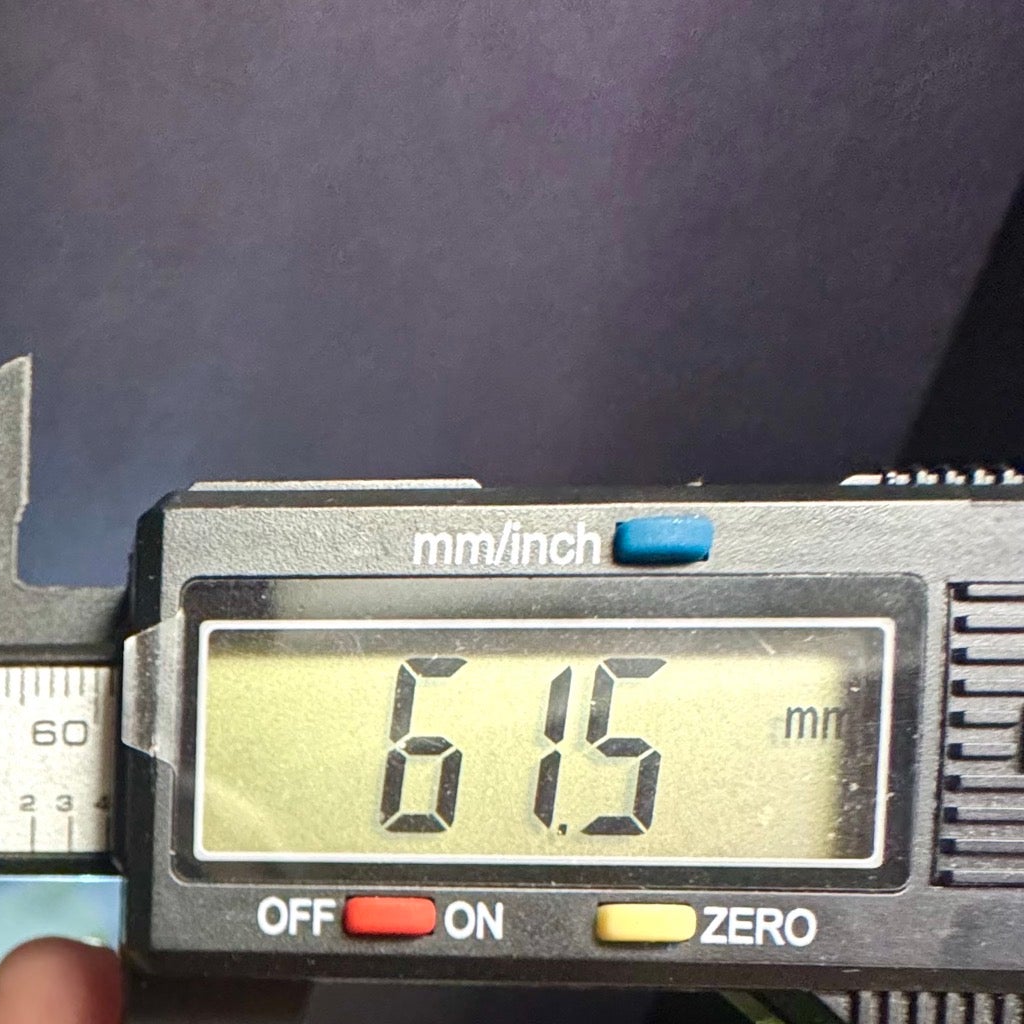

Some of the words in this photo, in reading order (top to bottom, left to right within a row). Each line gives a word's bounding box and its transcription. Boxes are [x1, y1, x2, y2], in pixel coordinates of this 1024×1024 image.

[412, 522, 602, 567] mm/inch
[31, 719, 88, 747] 60
[19, 794, 37, 813] 2
[55, 794, 74, 813] 3
[257, 896, 336, 937] OFF
[443, 900, 504, 940] ON
[700, 906, 818, 948] ZERO
